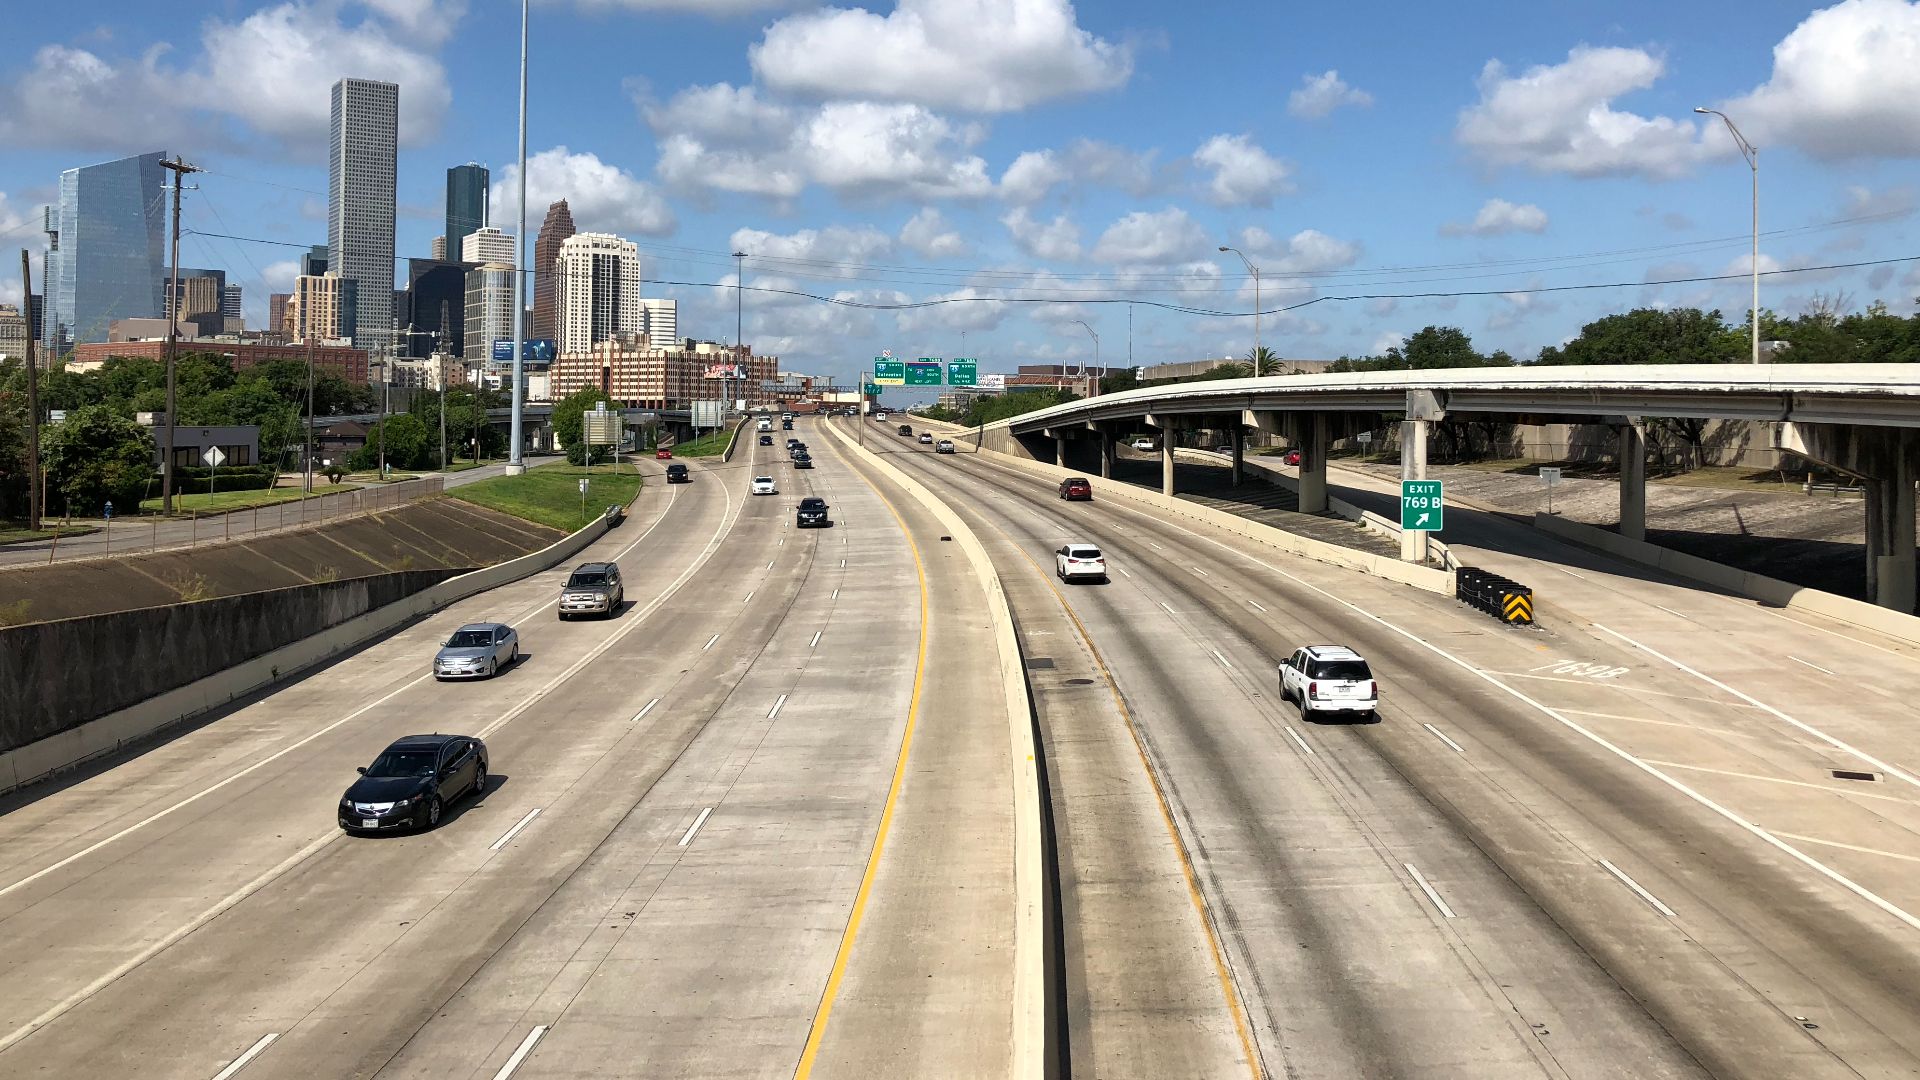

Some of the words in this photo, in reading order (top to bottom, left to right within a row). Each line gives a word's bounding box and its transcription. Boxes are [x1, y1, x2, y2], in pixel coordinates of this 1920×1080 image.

[1409, 485, 1435, 494] EXIT
[1403, 496, 1428, 509] 769
[1431, 497, 1441, 509] B
[1528, 659, 1630, 679] 769B
